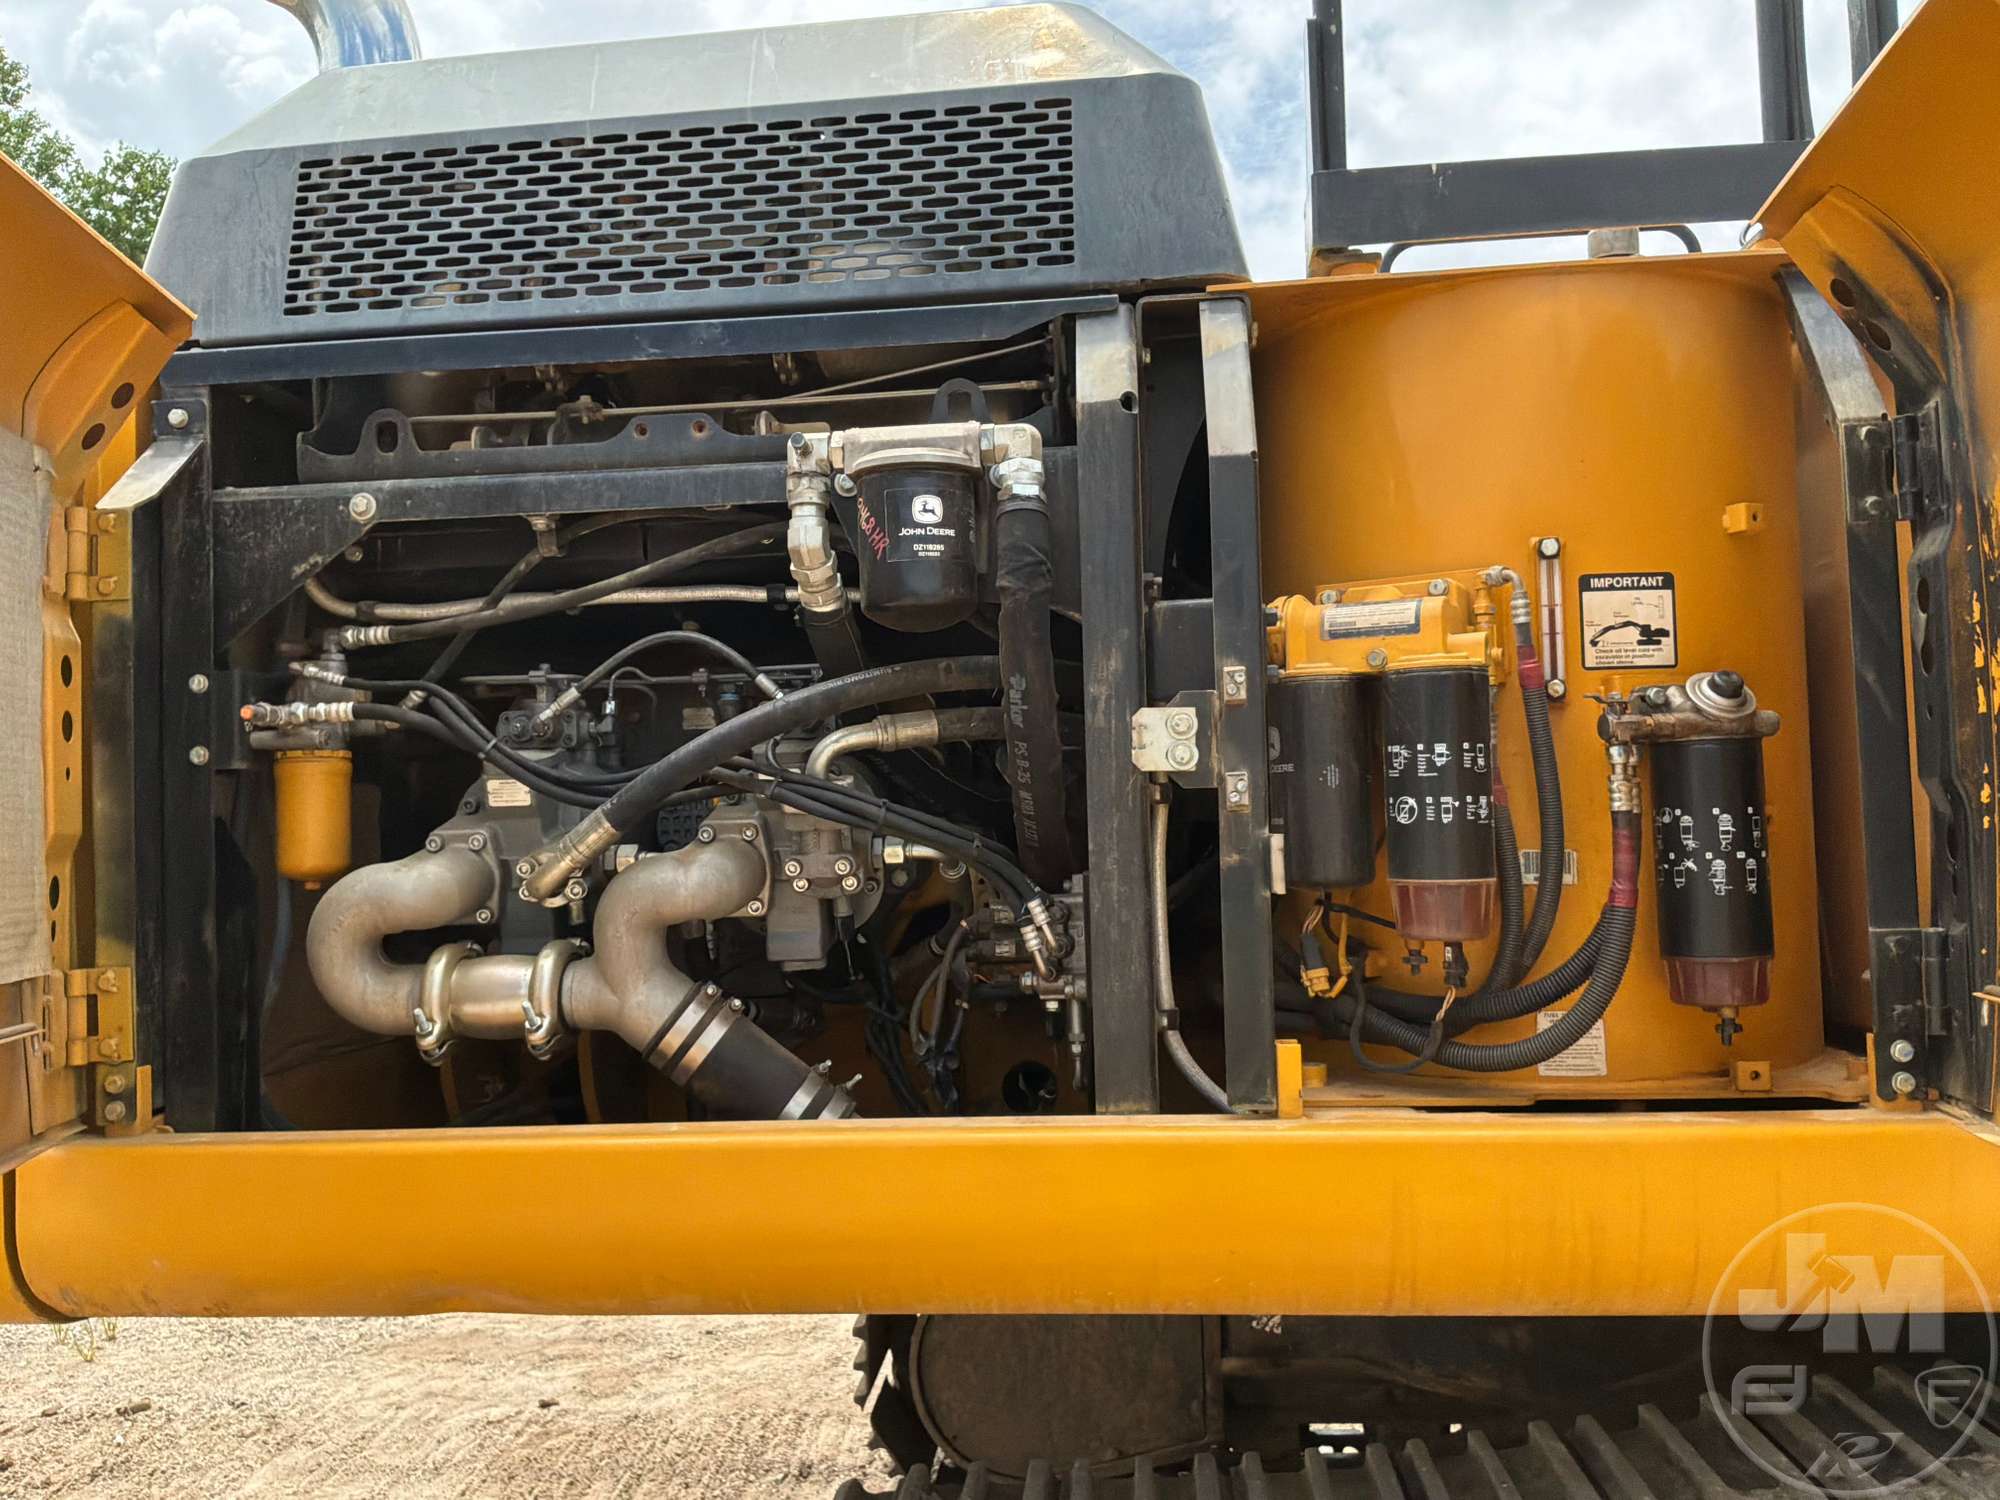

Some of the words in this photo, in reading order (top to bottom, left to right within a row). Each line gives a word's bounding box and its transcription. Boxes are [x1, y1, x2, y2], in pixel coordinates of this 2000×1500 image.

[898, 528, 925, 536] JOHN
[926, 527, 955, 536] DEERE
[1590, 576, 1664, 588] IMPORTANT
